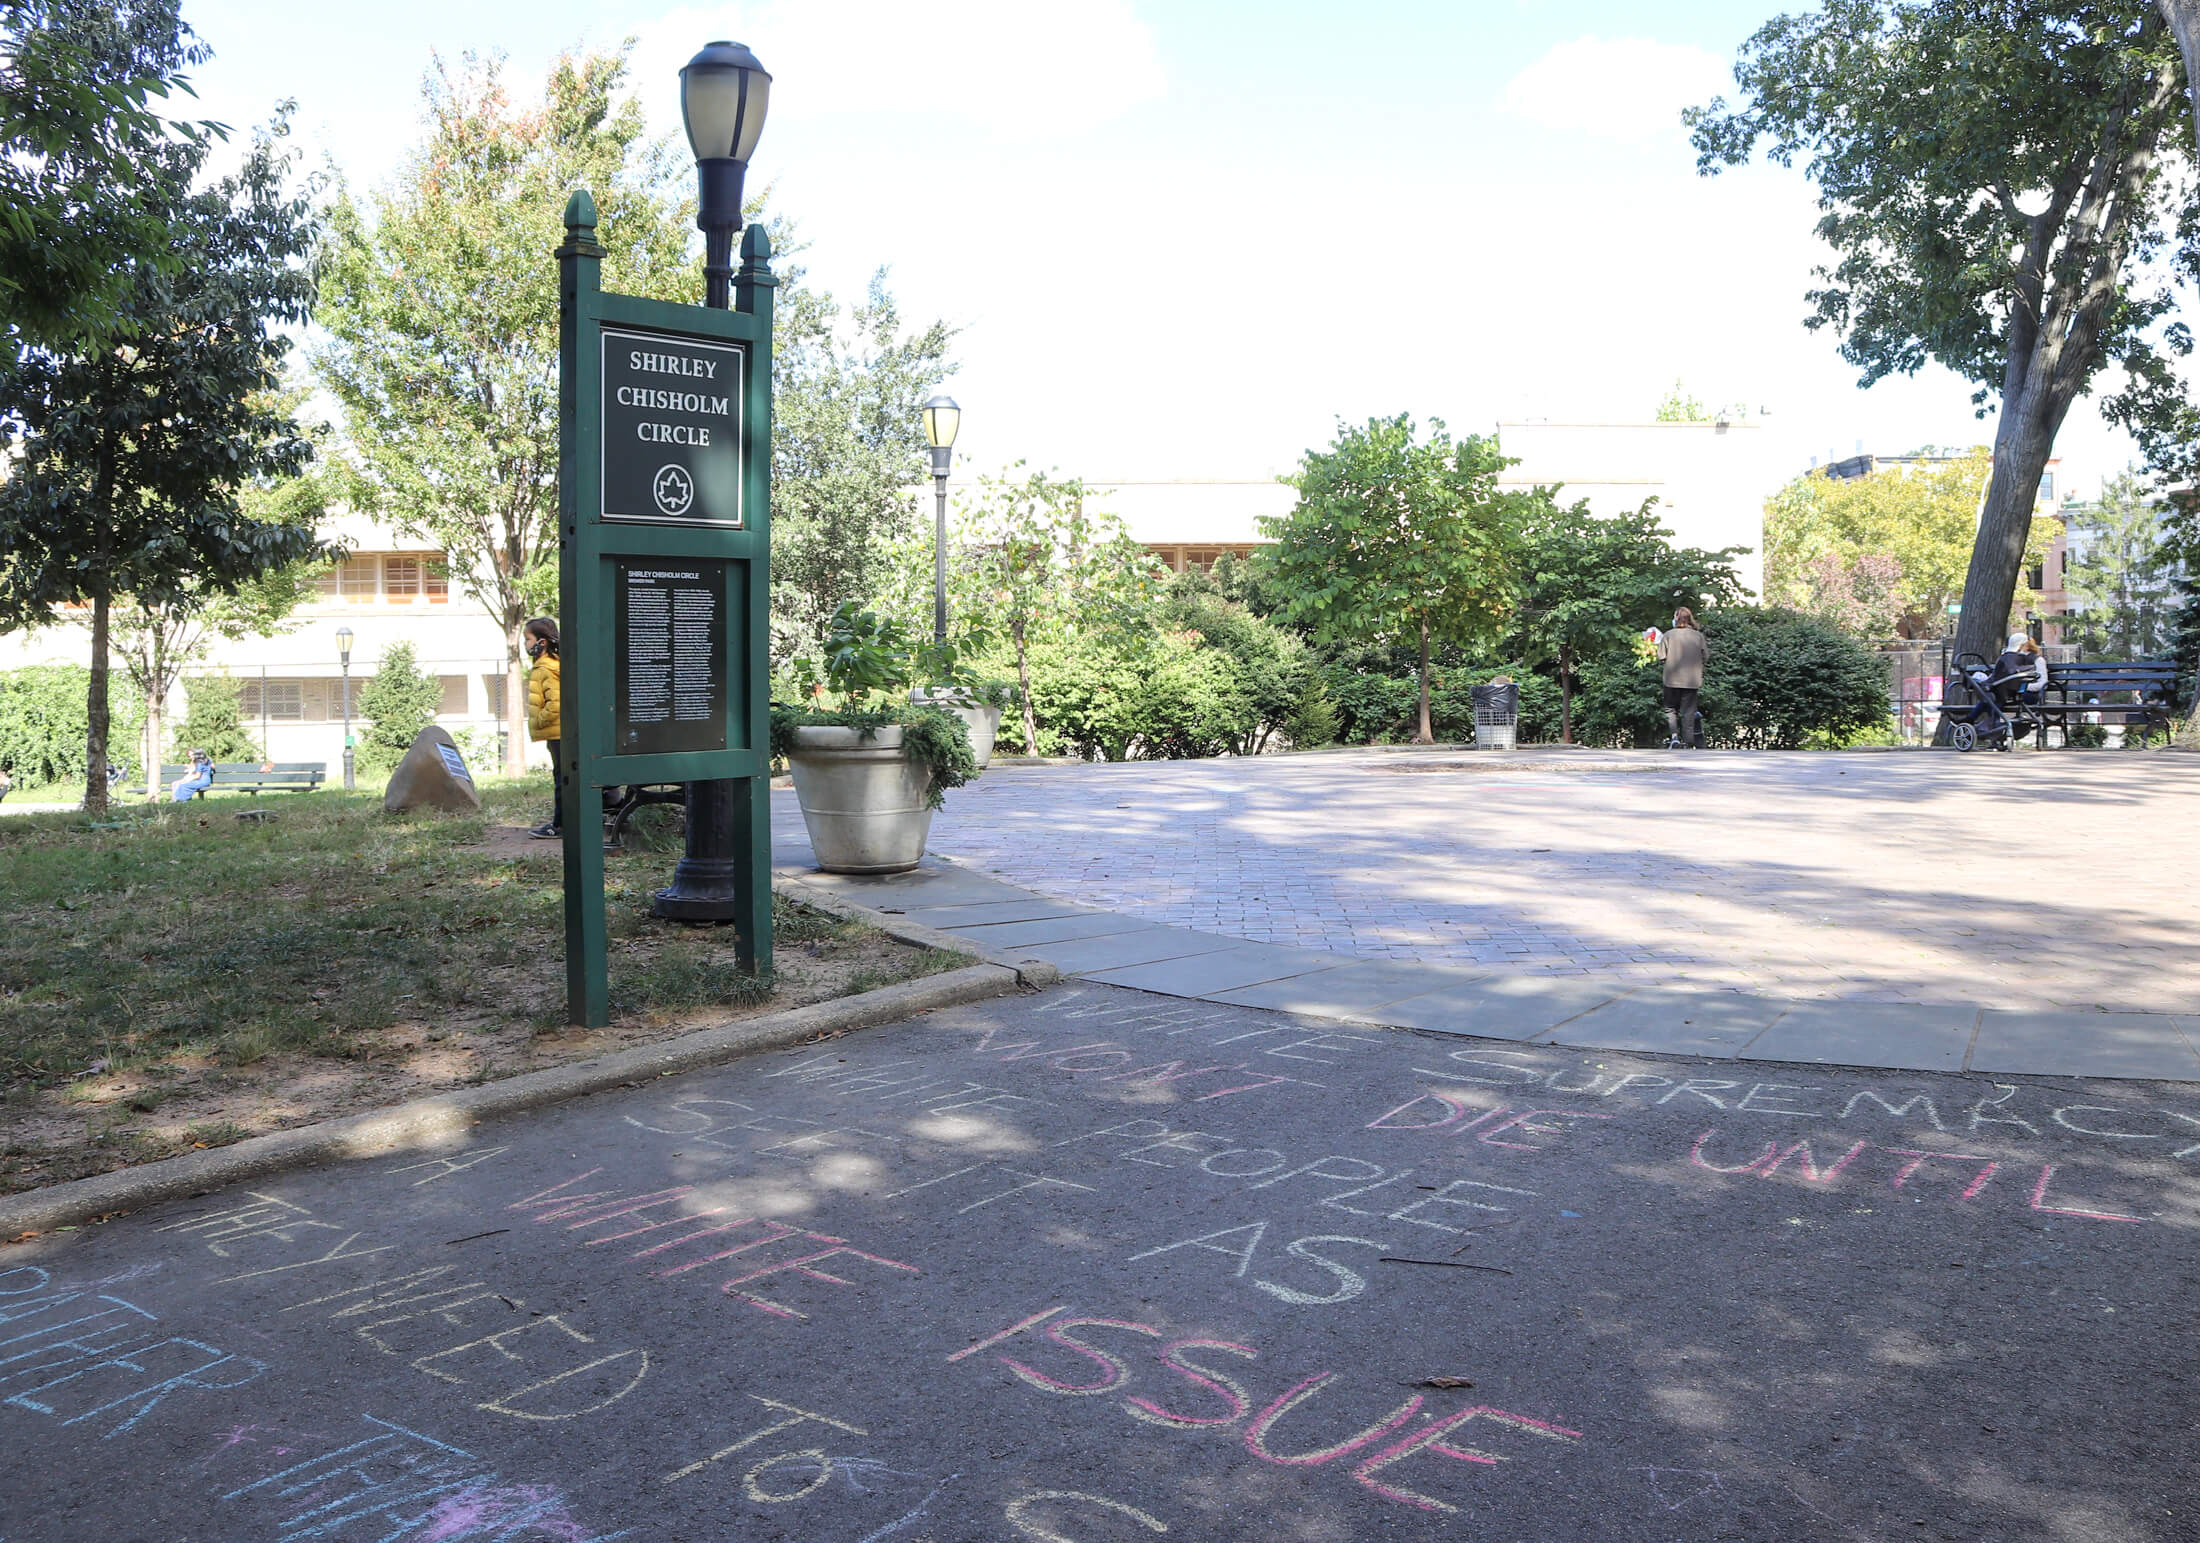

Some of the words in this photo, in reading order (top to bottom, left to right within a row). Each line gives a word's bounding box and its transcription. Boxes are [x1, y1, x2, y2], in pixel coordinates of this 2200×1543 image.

[616, 386, 729, 416] CHISHOLM
[629, 350, 718, 379] SHIRLEY
[636, 422, 711, 447] CIRCLE
[628, 570, 652, 578] SHIRLEY
[1033, 990, 1384, 1064] WHITE
[766, 1053, 1062, 1122] WHITE
[1053, 1119, 1537, 1236] PEOPLE
[1366, 1093, 1614, 1152] DIE
[1690, 1129, 2156, 1224] UNTIL
[624, 1099, 901, 1162] SEE
[886, 1160, 1098, 1216] IT
[1127, 1221, 1391, 1305] AS
[154, 1191, 396, 1284] THEY
[278, 1264, 650, 1422] NEED
[661, 1394, 869, 1504] TO
[385, 1146, 511, 1186] A
[506, 1167, 920, 1320] WHITE
[946, 1305, 1582, 1512] ISSUE
